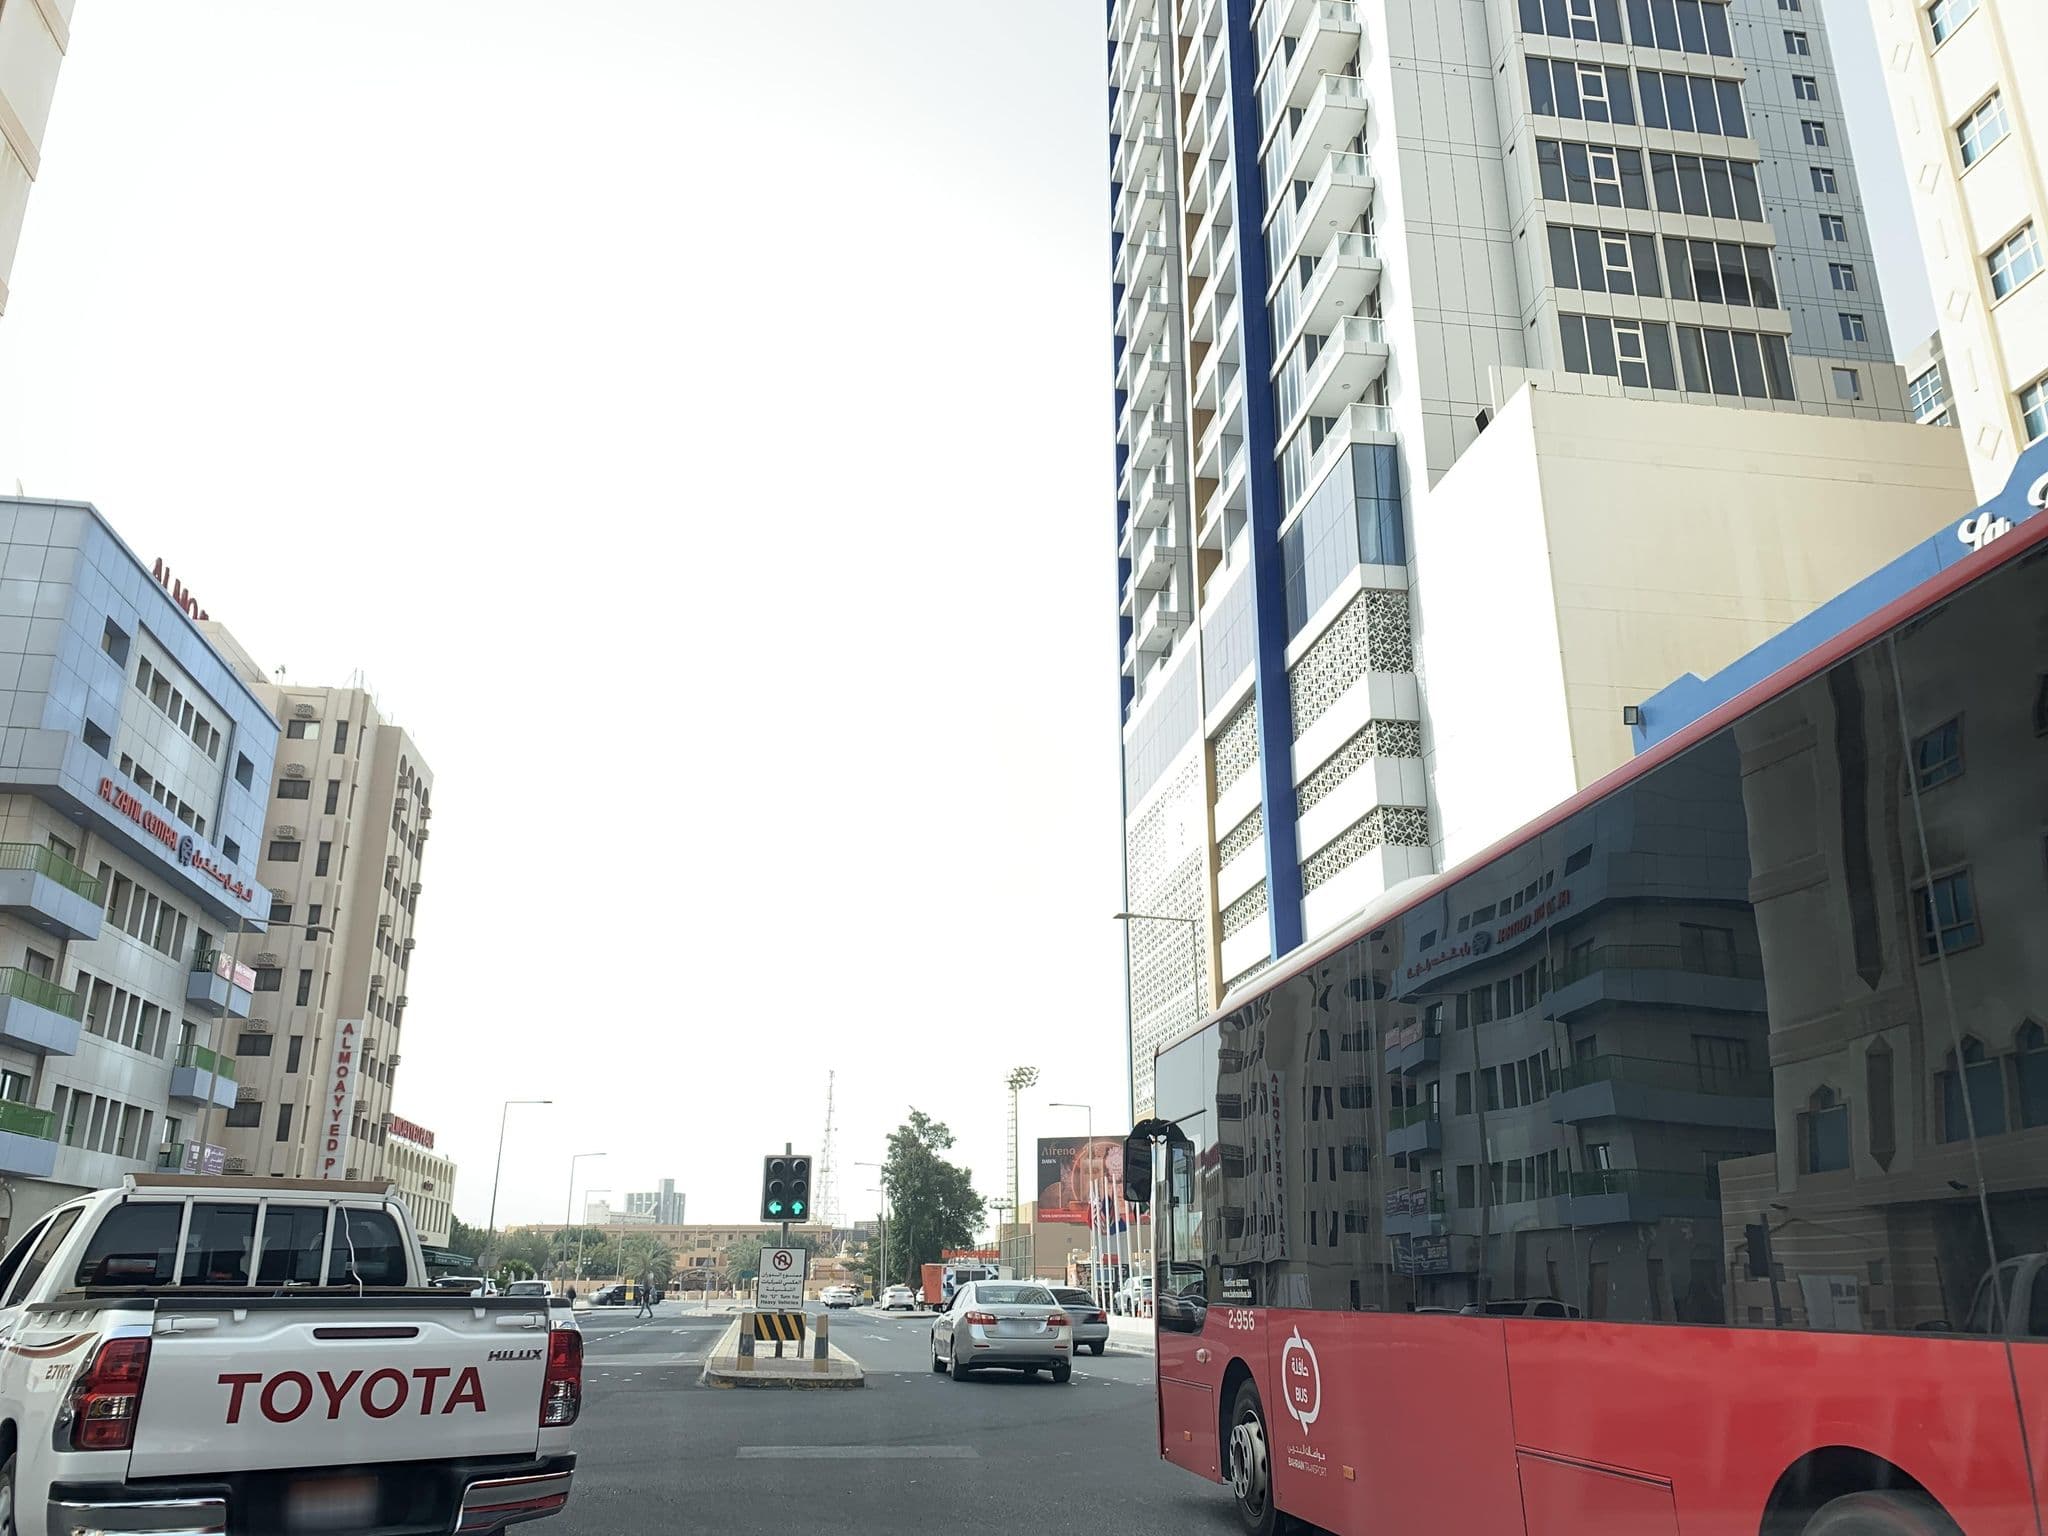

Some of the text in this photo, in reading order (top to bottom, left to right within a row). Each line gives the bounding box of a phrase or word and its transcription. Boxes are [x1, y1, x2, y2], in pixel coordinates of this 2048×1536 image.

[98, 777, 112, 802] AL
[326, 1022, 354, 1151] ALMOAYYED
[1228, 1309, 1255, 1331] 2-956
[487, 1348, 544, 1361] HILUX
[1291, 1357, 1309, 1377] حافلة
[217, 1366, 487, 1424] TOYOTA
[1295, 1387, 1308, 1403] BUS
